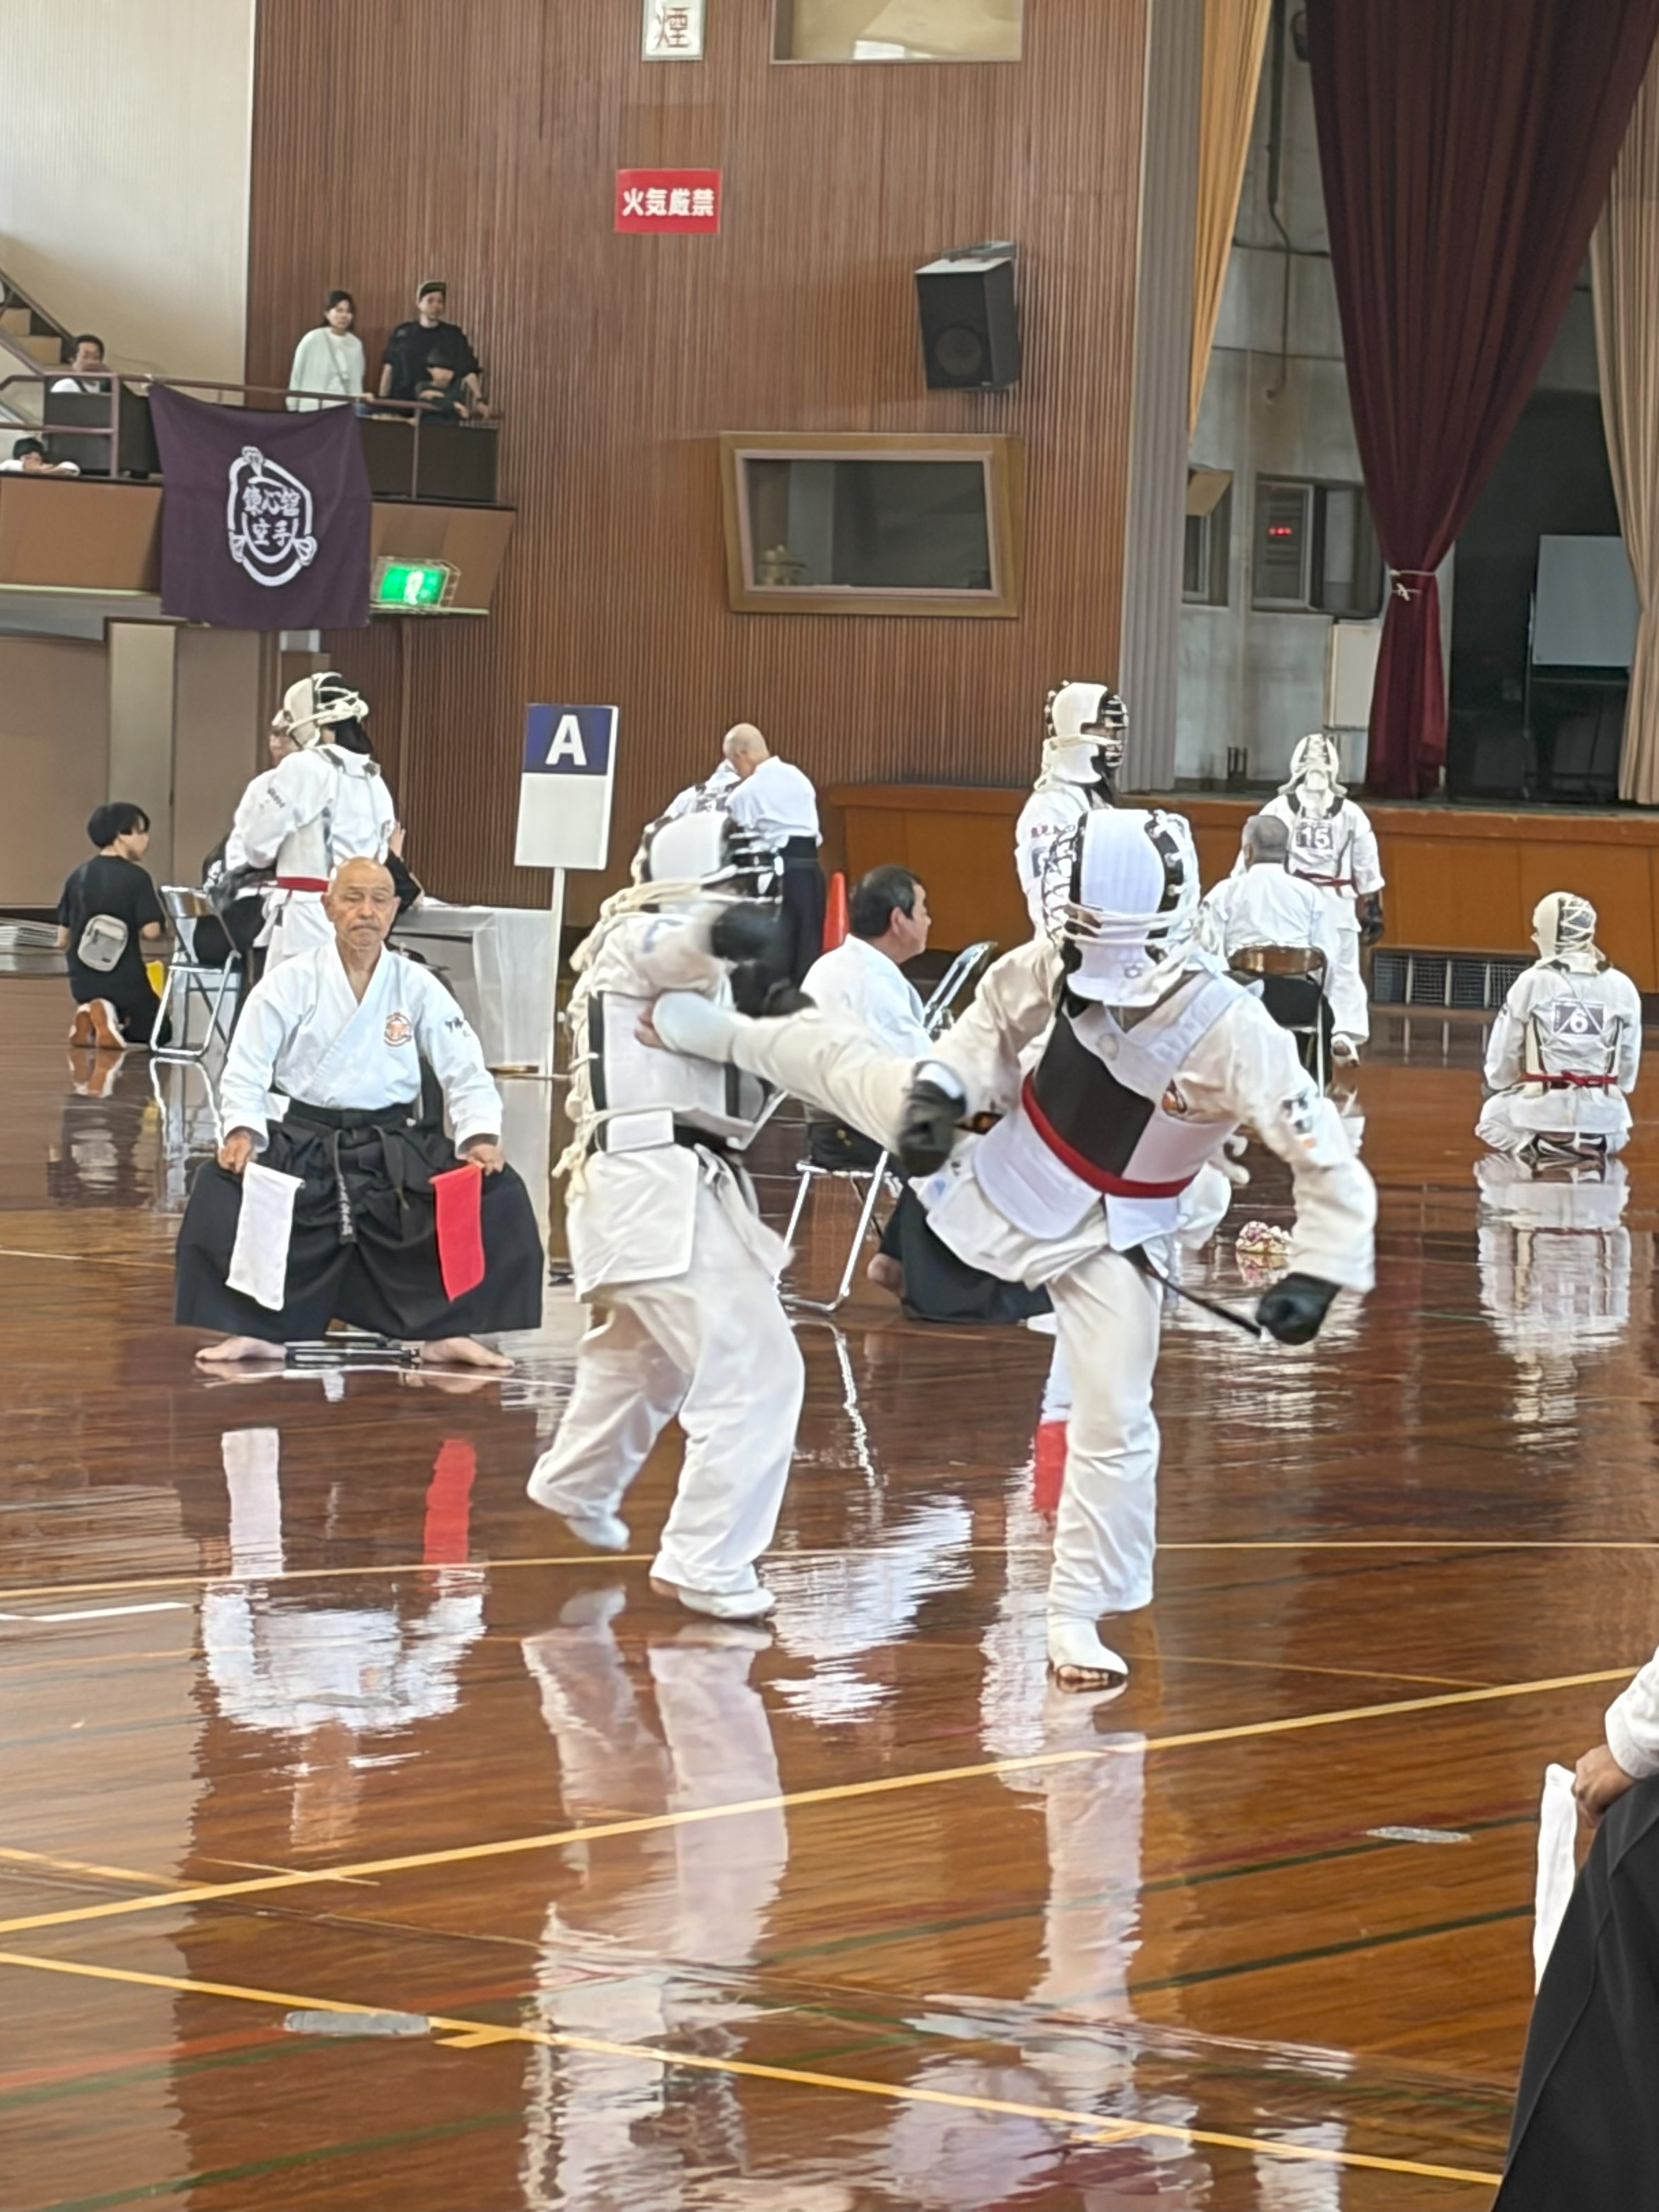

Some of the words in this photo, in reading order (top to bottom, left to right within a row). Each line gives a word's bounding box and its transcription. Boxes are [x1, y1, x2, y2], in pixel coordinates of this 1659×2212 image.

[622, 188, 715, 217] 火気厳禁
[252, 517, 291, 546] 空手
[545, 714, 587, 765] A
[1301, 827, 1330, 849] 15
[1570, 1008, 1589, 1032] 6
